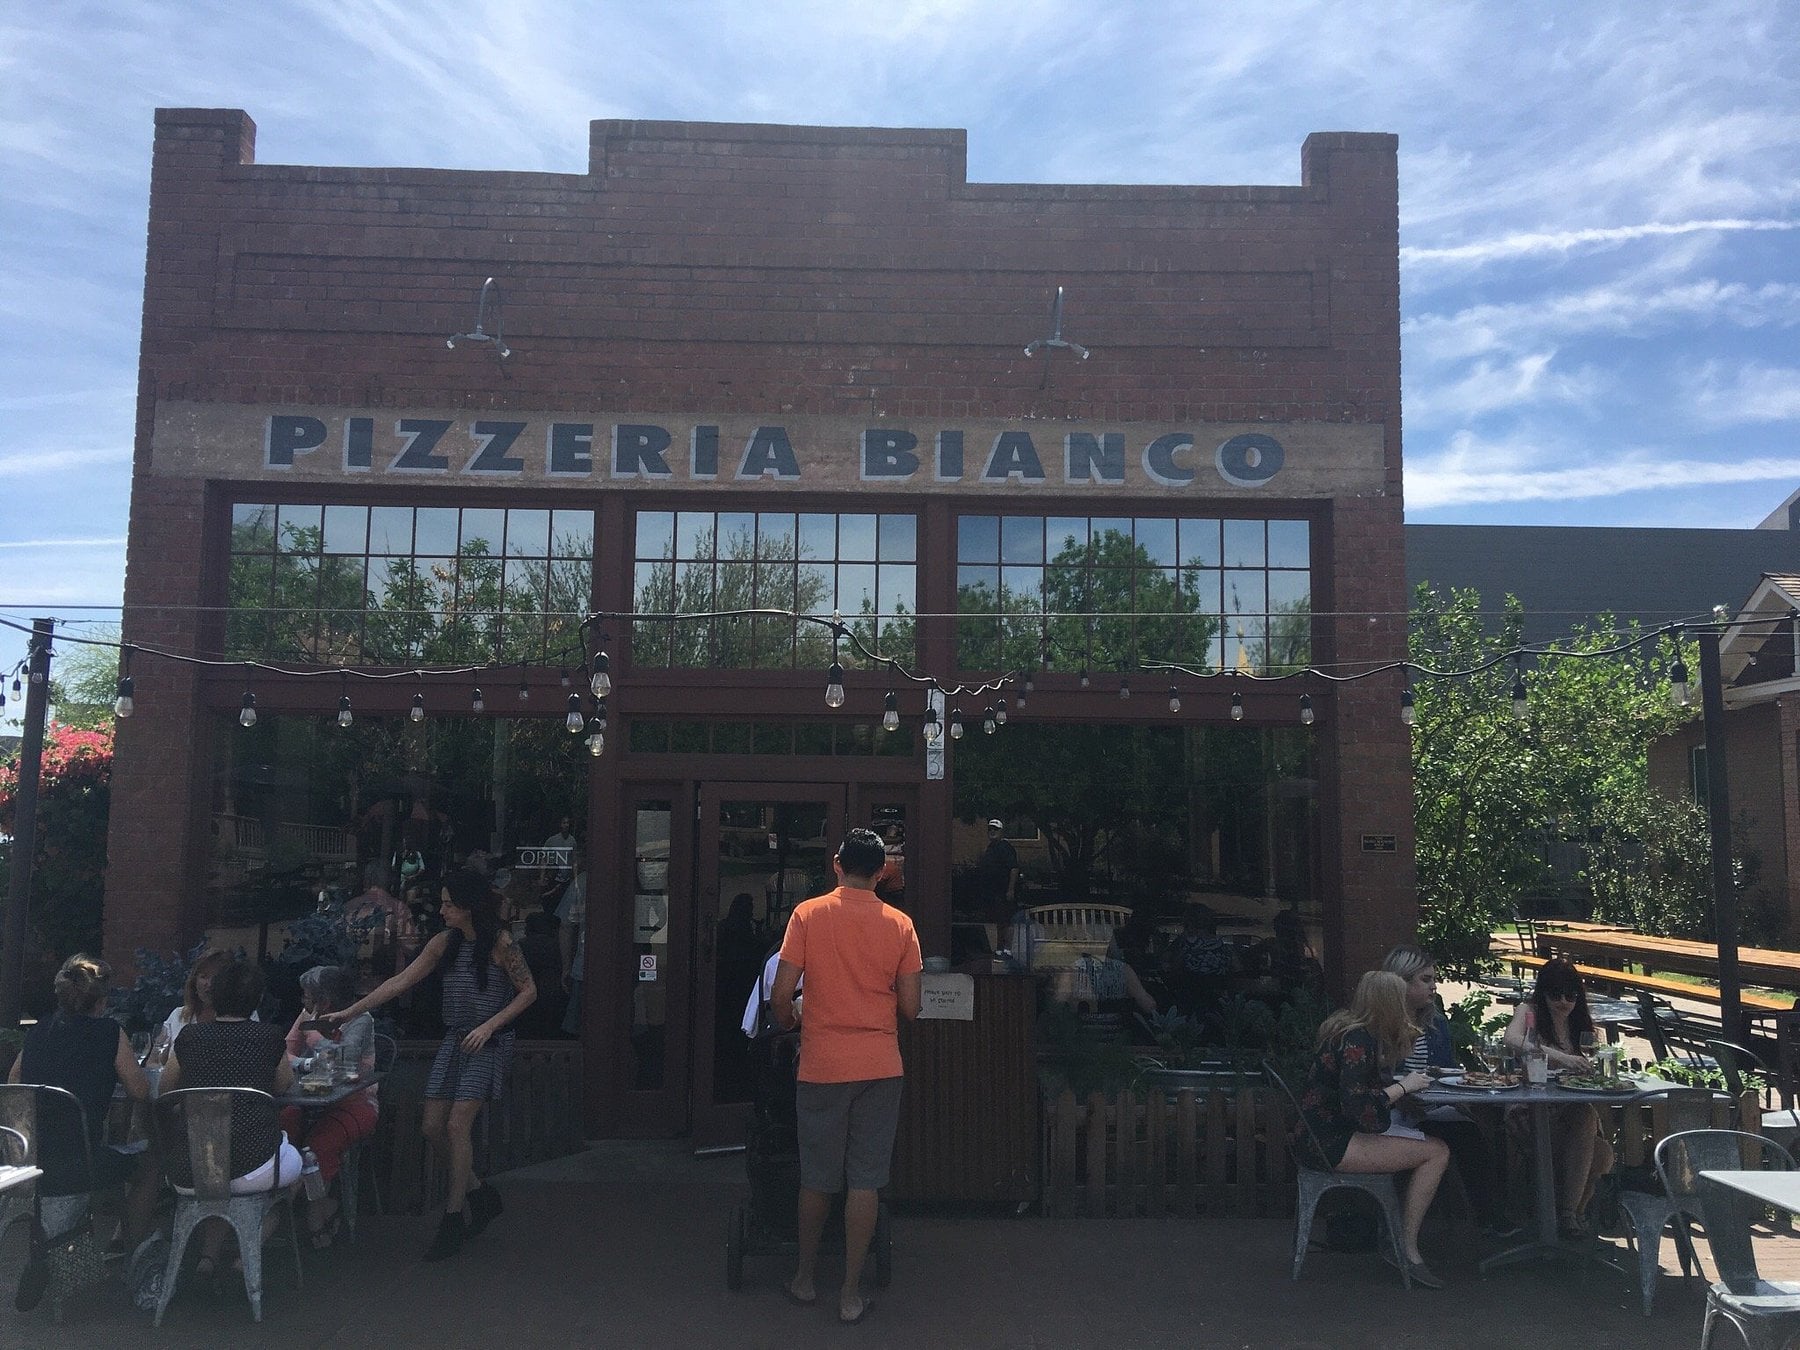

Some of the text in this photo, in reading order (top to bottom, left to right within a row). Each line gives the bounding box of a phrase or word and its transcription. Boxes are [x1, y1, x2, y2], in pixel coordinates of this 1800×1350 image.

[263, 415, 1286, 488] PIZZERIA BIANCO
[520, 850, 568, 865] OPEN
